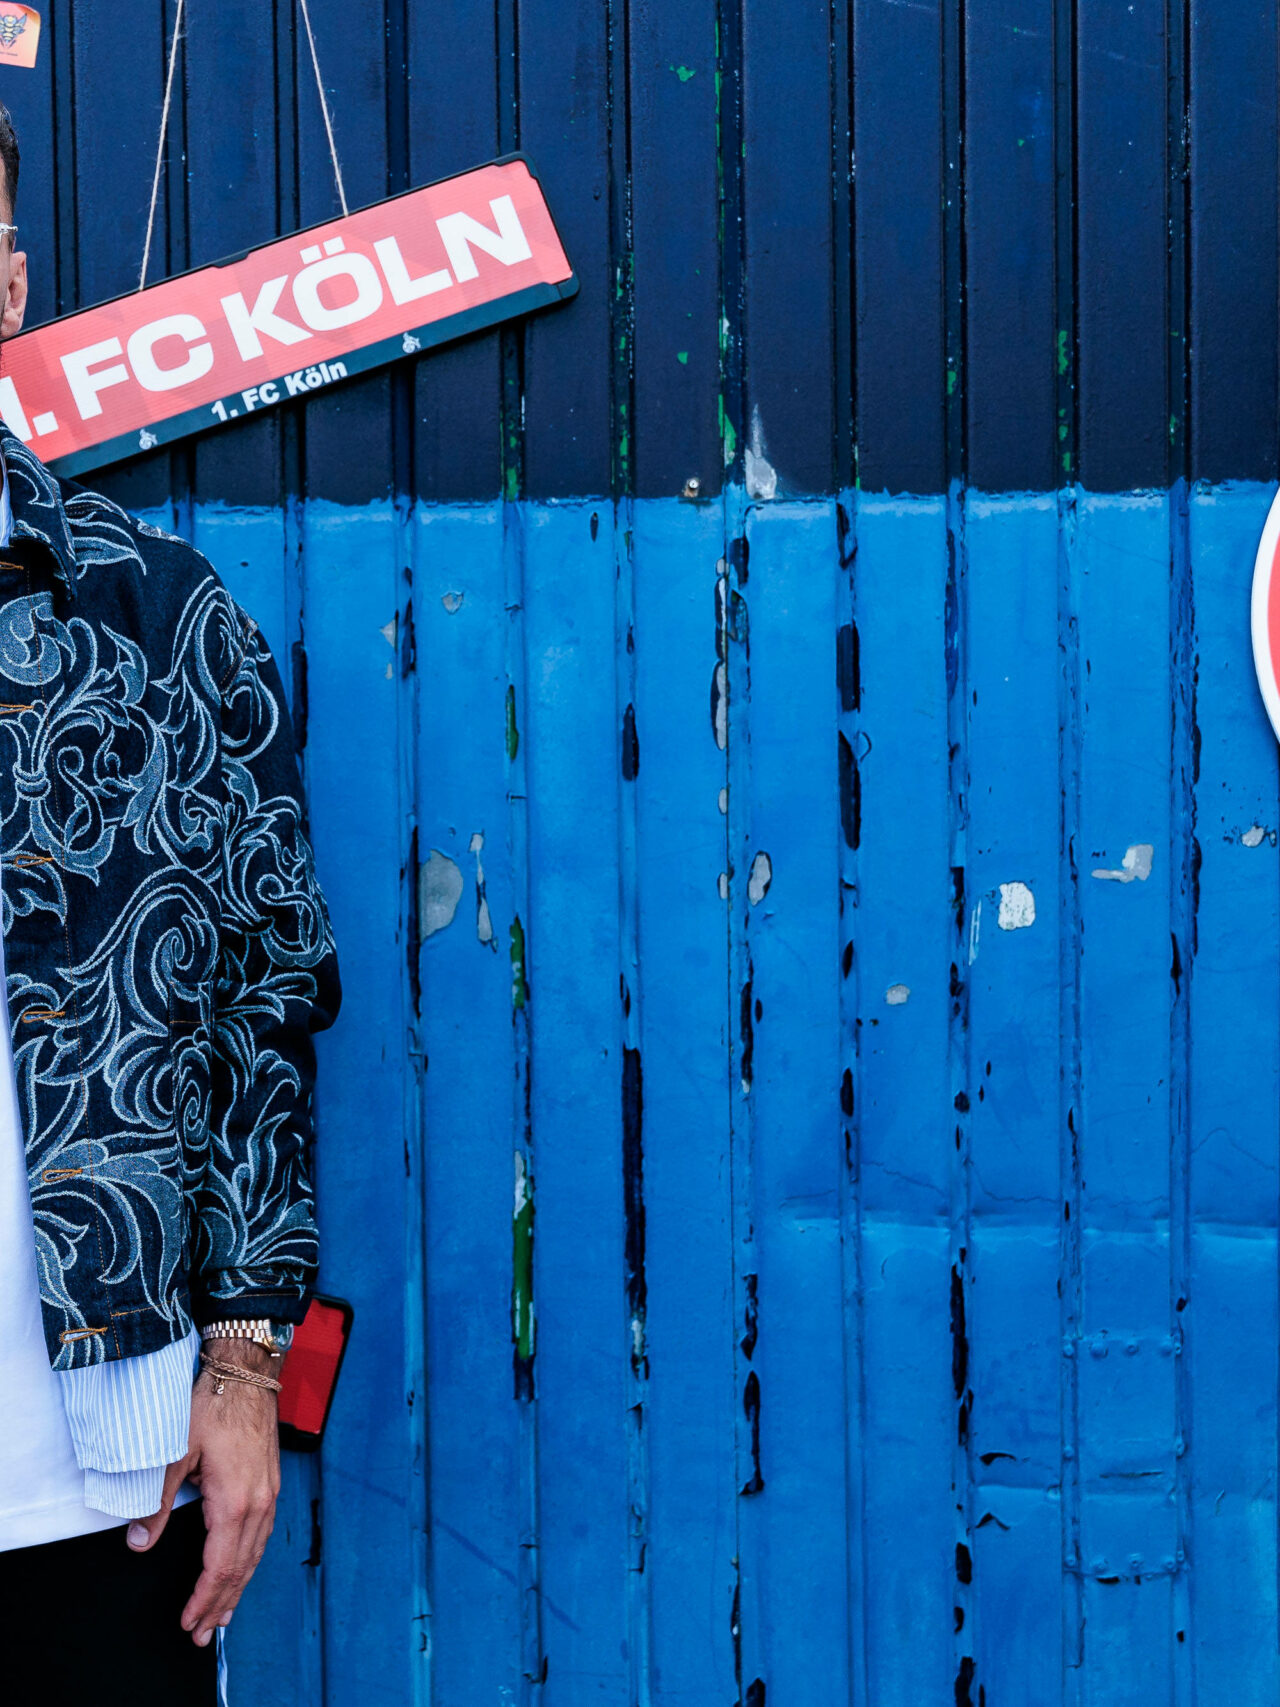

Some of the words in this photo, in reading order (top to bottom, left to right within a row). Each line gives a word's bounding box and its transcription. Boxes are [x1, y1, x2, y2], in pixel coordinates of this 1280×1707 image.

[59, 313, 214, 420] FC
[221, 194, 532, 362] KÖLN
[211, 400, 239, 422] 1.
[241, 382, 280, 412] FC
[283, 361, 347, 396] Köln
